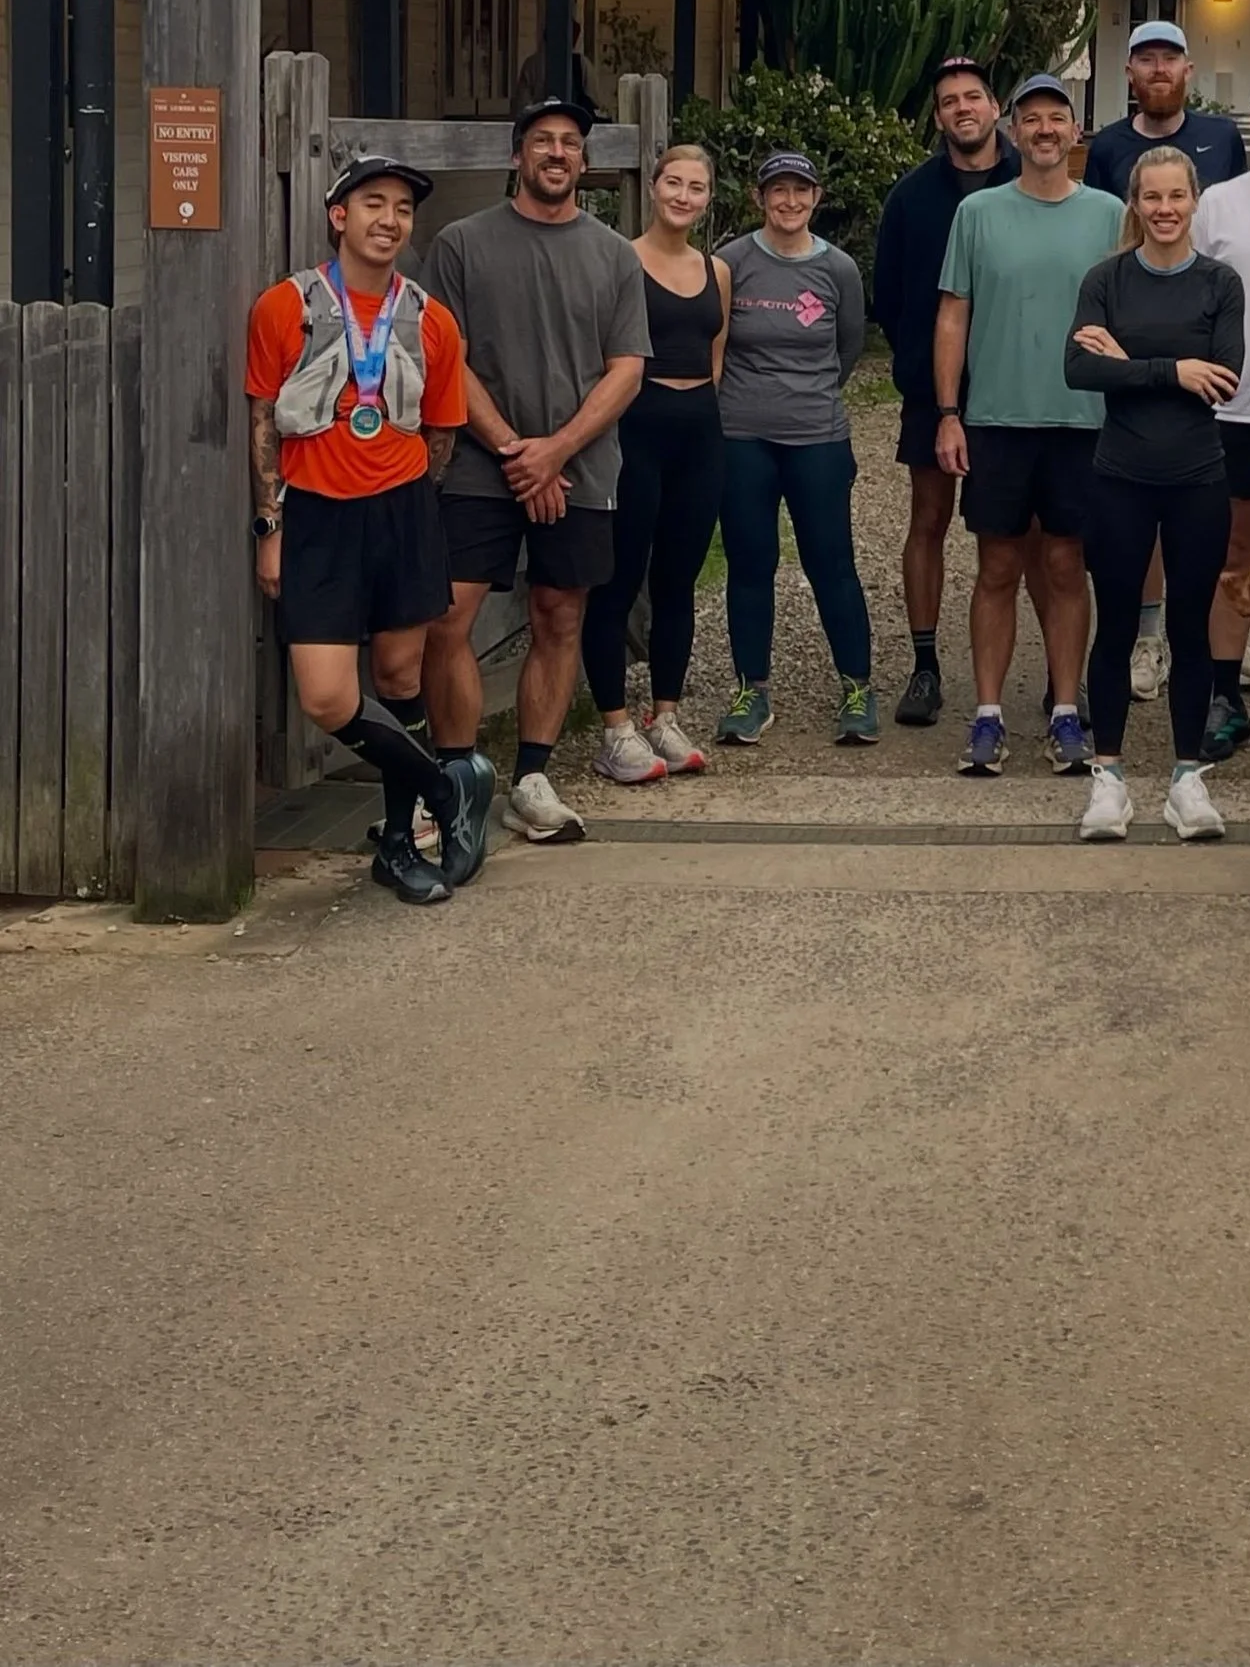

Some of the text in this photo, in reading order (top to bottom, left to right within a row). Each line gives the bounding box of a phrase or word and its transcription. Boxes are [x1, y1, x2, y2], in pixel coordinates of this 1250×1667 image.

[159, 127, 213, 140] NO ENTRY
[162, 152, 208, 164] VISITORS
[172, 166, 200, 178] CARS
[172, 180, 199, 192] ONLY
